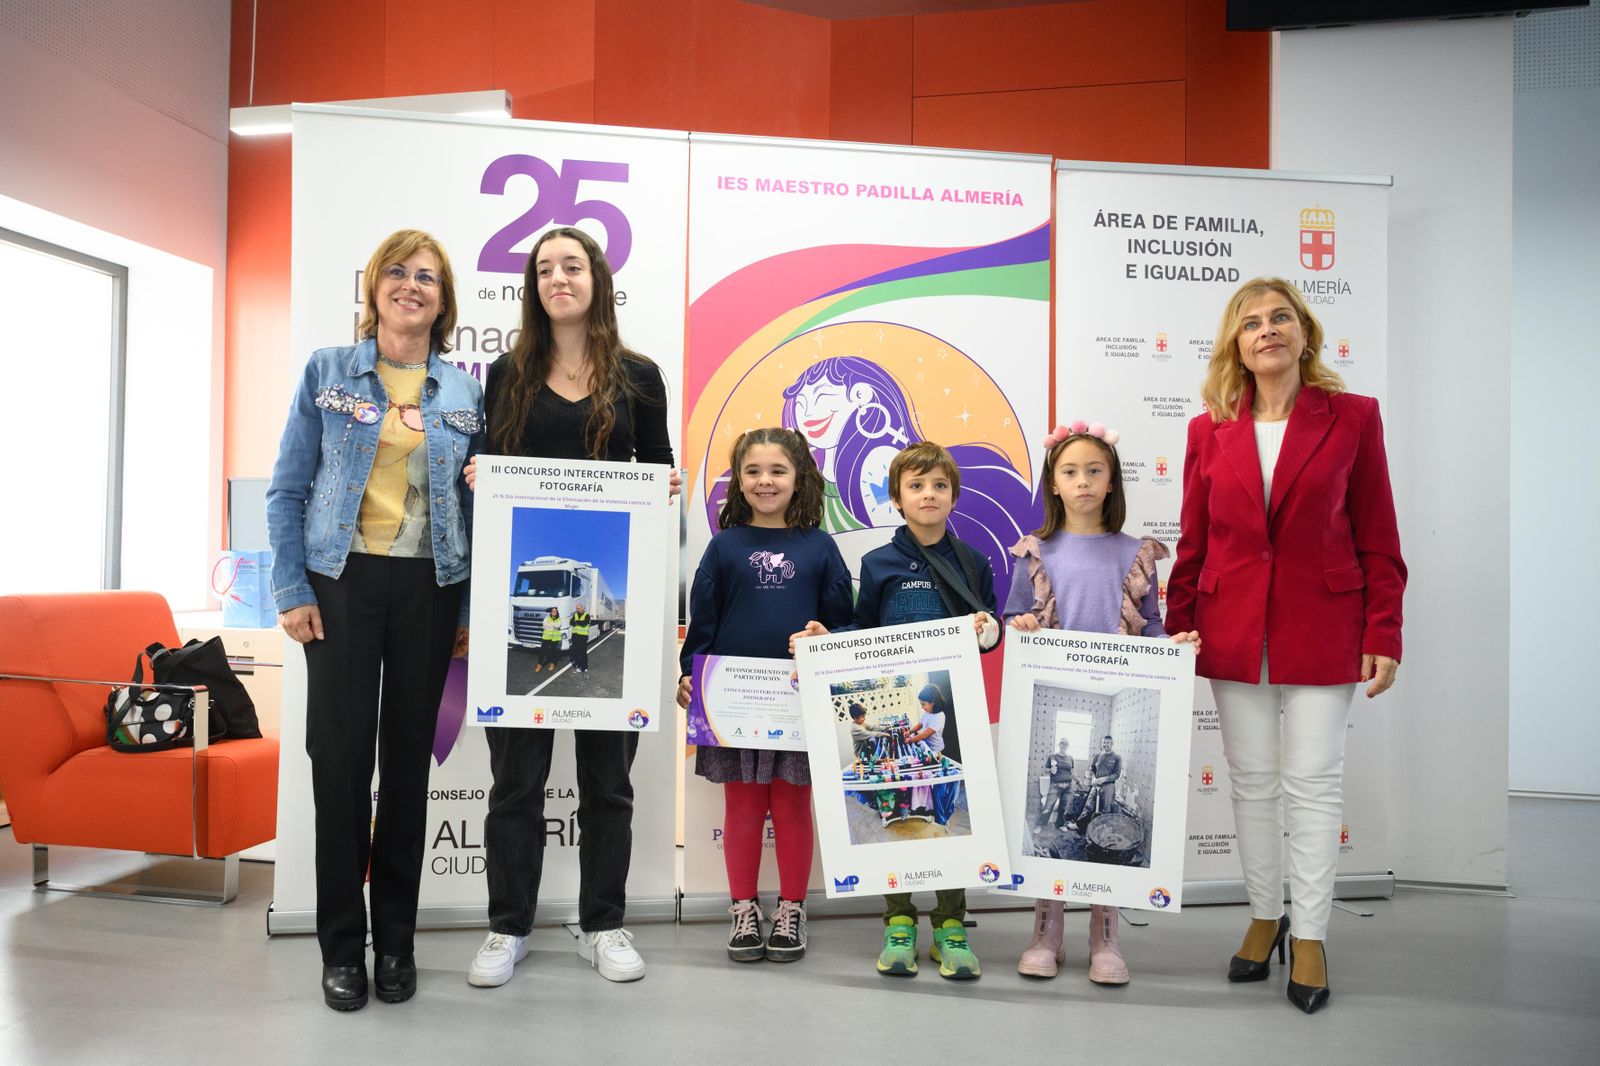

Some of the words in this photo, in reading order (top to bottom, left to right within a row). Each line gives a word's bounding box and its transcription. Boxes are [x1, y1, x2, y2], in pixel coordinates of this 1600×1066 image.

[717, 176, 749, 190] IES
[755, 178, 850, 196] MAESTRO
[856, 184, 935, 201] PADILLA
[940, 188, 1024, 206] ALMERÍA
[476, 154, 632, 276] 25
[1094, 210, 1146, 229] ÁREA
[1152, 215, 1178, 230] DE
[1184, 216, 1264, 237] FAMILIA,
[1128, 238, 1232, 258] INCLUSIÓN
[1126, 264, 1137, 279] E
[1144, 264, 1240, 282] IGUALDAD
[478, 288, 496, 300] de
[1304, 296, 1336, 304] IUDAD
[491, 465, 501, 474] III
[504, 466, 561, 477] CONCURSO
[564, 469, 639, 481] INTERCENTROS
[642, 473, 655, 481] DE
[540, 481, 604, 493] FOTOGRAFÍA
[902, 581, 931, 589] CAMPUS
[809, 644, 818, 653] III
[820, 637, 872, 652] CONCURSO
[875, 627, 945, 645] INTERCENTROS
[948, 626, 960, 636] DE
[1020, 636, 1030, 644] III
[1032, 636, 1087, 649] CONCURSO
[1090, 642, 1164, 656] INTERCENTROS
[1167, 648, 1180, 657] DE
[855, 645, 914, 661] FOTOGRAFÍA
[1067, 653, 1129, 666] FOTOGRAFÍA
[552, 709, 591, 718] ALMERÍA
[558, 788, 575, 798] LA
[432, 810, 580, 850] ALRÍ
[432, 856, 488, 875] CIUD
[904, 868, 942, 880] ALMERÍA
[1072, 882, 1112, 894] ALMERÍA
